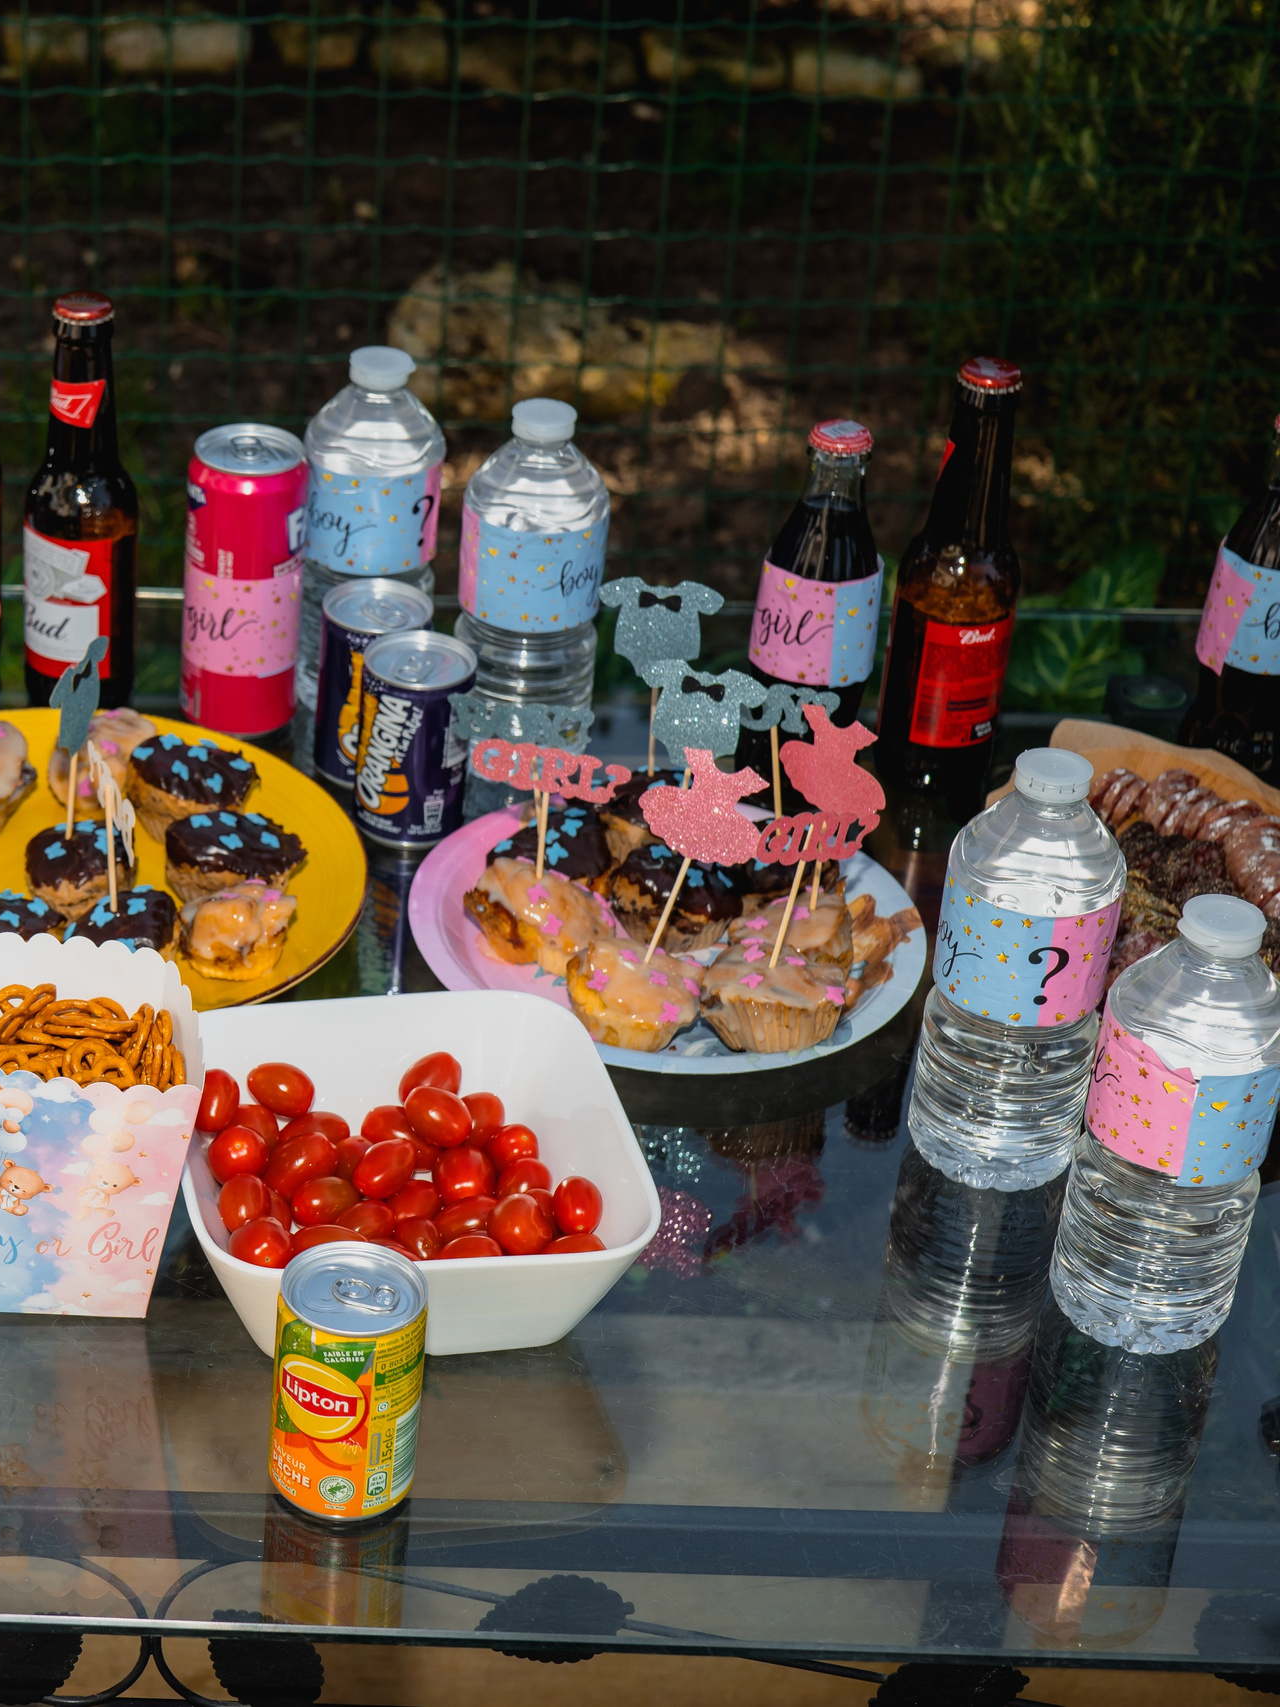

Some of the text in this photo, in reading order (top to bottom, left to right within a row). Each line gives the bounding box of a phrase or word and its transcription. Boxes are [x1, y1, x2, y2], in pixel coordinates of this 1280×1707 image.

[541, 560, 599, 608] boy
[187, 606, 259, 642] girl
[756, 607, 834, 646] girl
[959, 627, 995, 645] Bud
[357, 694, 413, 810] ORANGINA
[472, 738, 632, 804] GIRL?
[756, 811, 881, 867] GIRL?
[937, 919, 1070, 1007] oy ?
[35, 1235, 73, 1258] or
[87, 1221, 161, 1264] Girl
[389, 1358, 404, 1369] 805
[285, 1374, 350, 1414] Lipton
[273, 1450, 311, 1489] PÊCHE
[274, 1439, 306, 1473] SAVEUR
